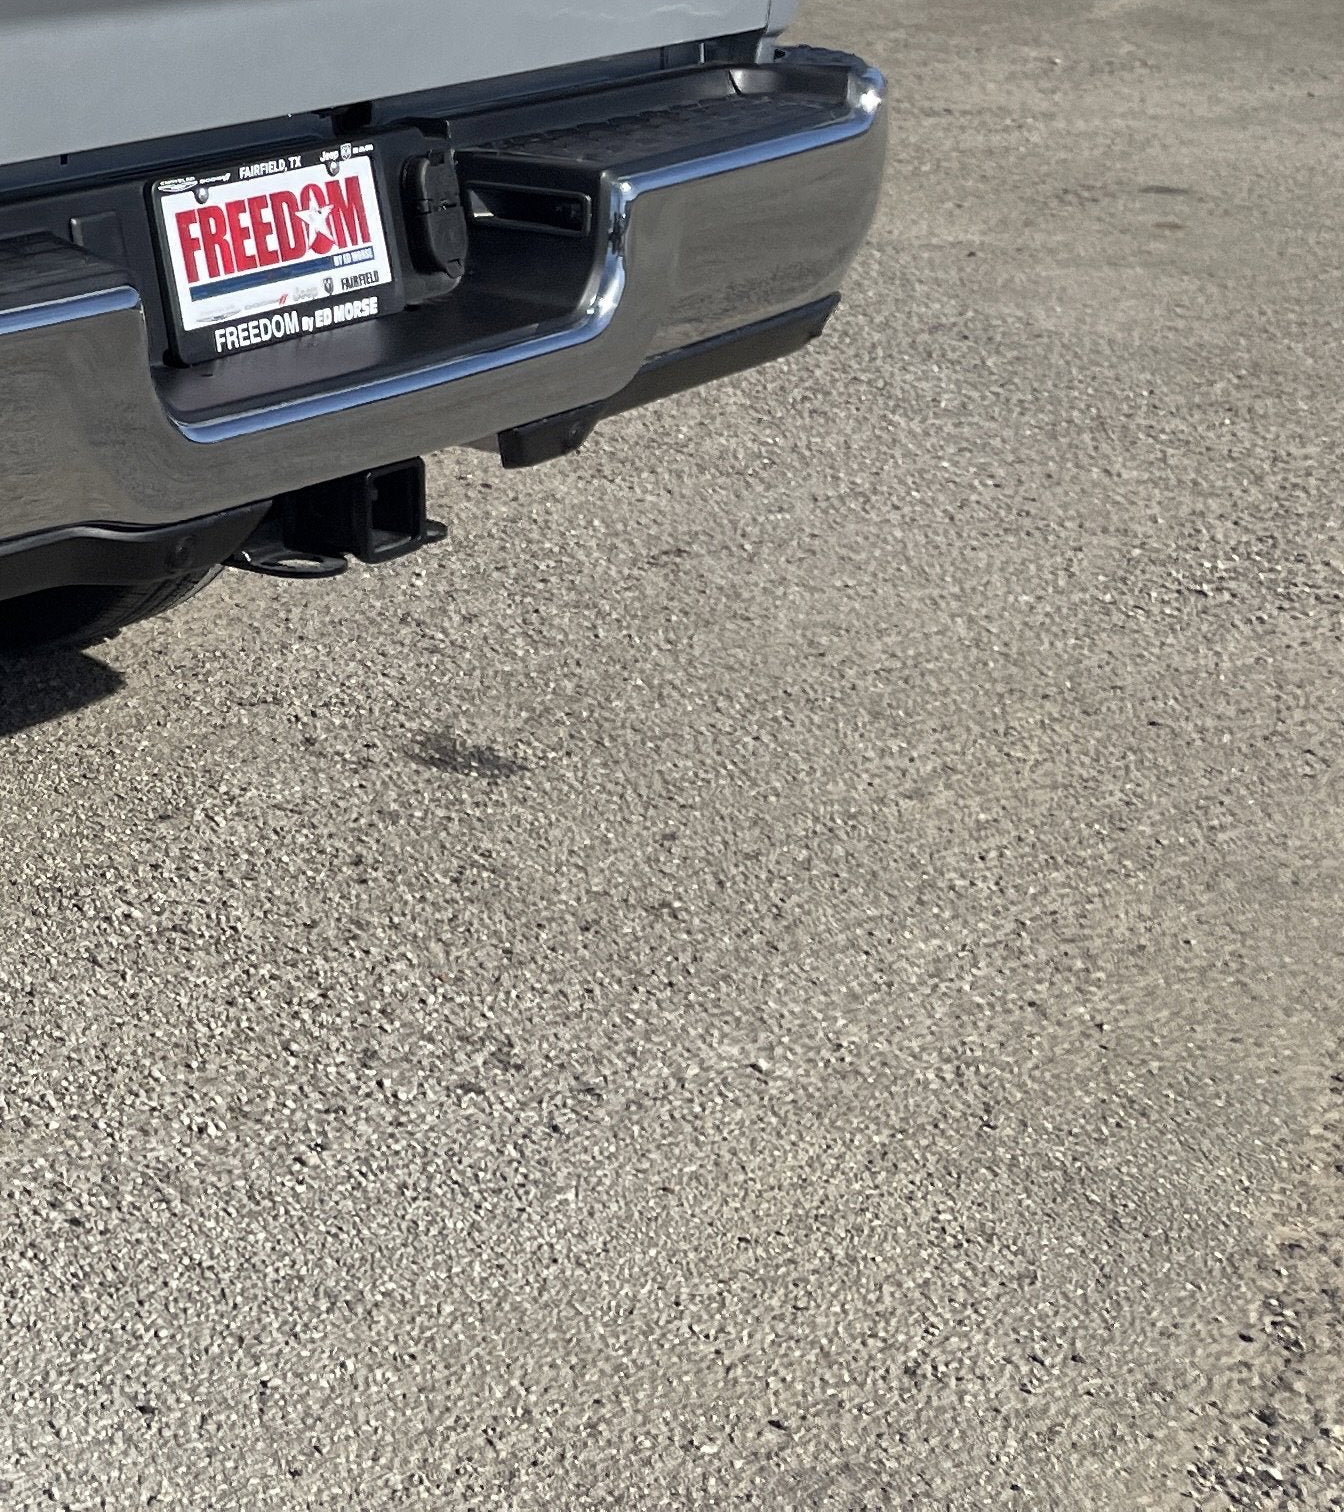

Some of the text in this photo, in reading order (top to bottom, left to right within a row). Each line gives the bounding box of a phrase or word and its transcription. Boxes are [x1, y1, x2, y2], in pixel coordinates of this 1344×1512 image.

[239, 155, 302, 180] FAIRFIELD, TX
[175, 175, 372, 284] FREEDOM
[340, 270, 379, 291] FAIRFIELD
[214, 310, 300, 353] FREEDOM
[314, 307, 333, 329] ED
[333, 296, 379, 325] MORSE
